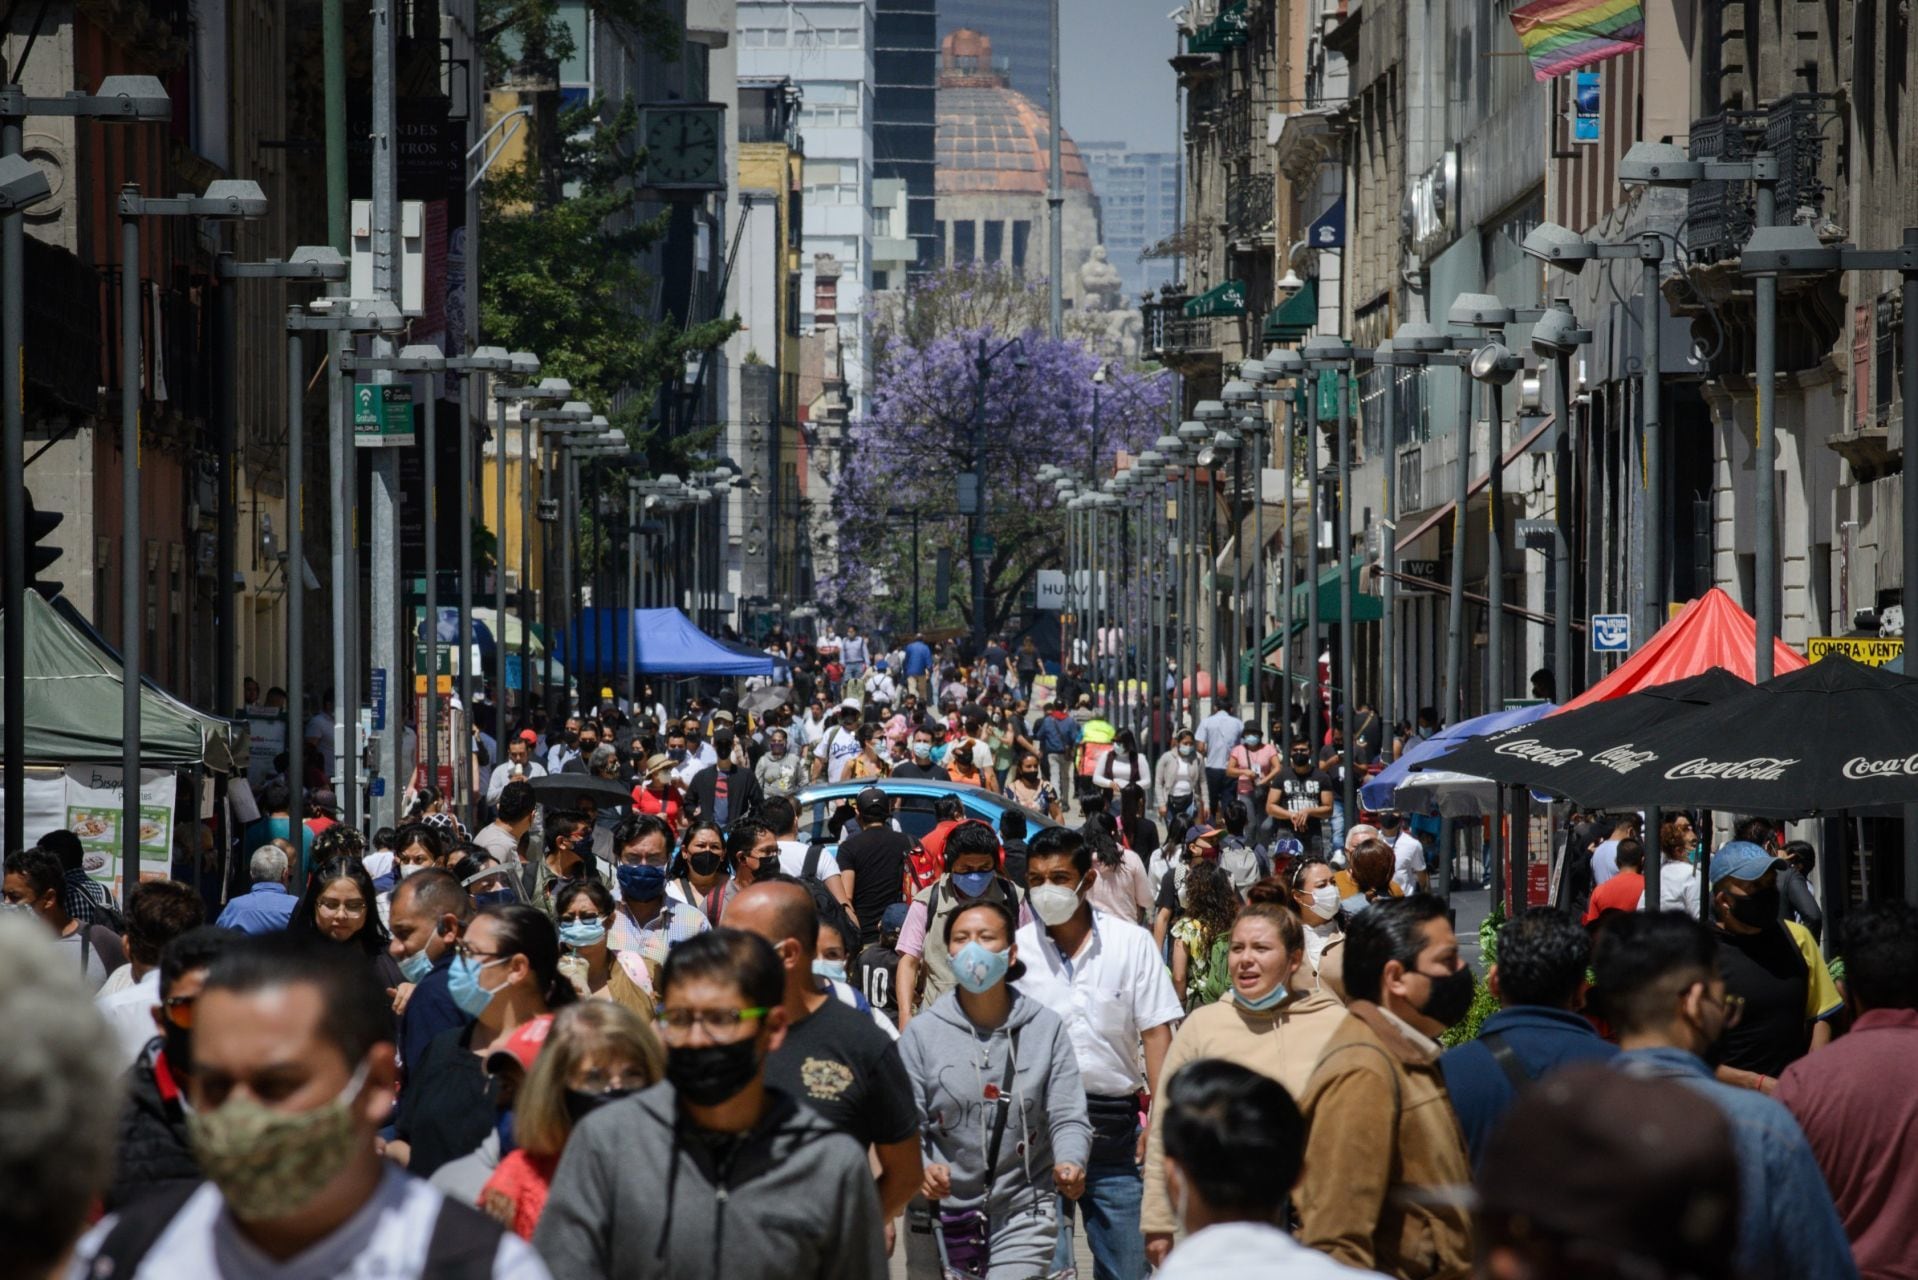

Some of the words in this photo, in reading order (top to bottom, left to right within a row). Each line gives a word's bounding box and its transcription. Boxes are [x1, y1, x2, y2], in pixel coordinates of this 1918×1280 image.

[353, 120, 438, 137] GNDES
[1410, 562, 1435, 576] WC
[1494, 739, 1584, 768] Coca-Cola
[1664, 757, 1802, 781] Coca-Cola
[862, 964, 889, 1008] 10
[938, 1063, 1036, 1131] Smie
